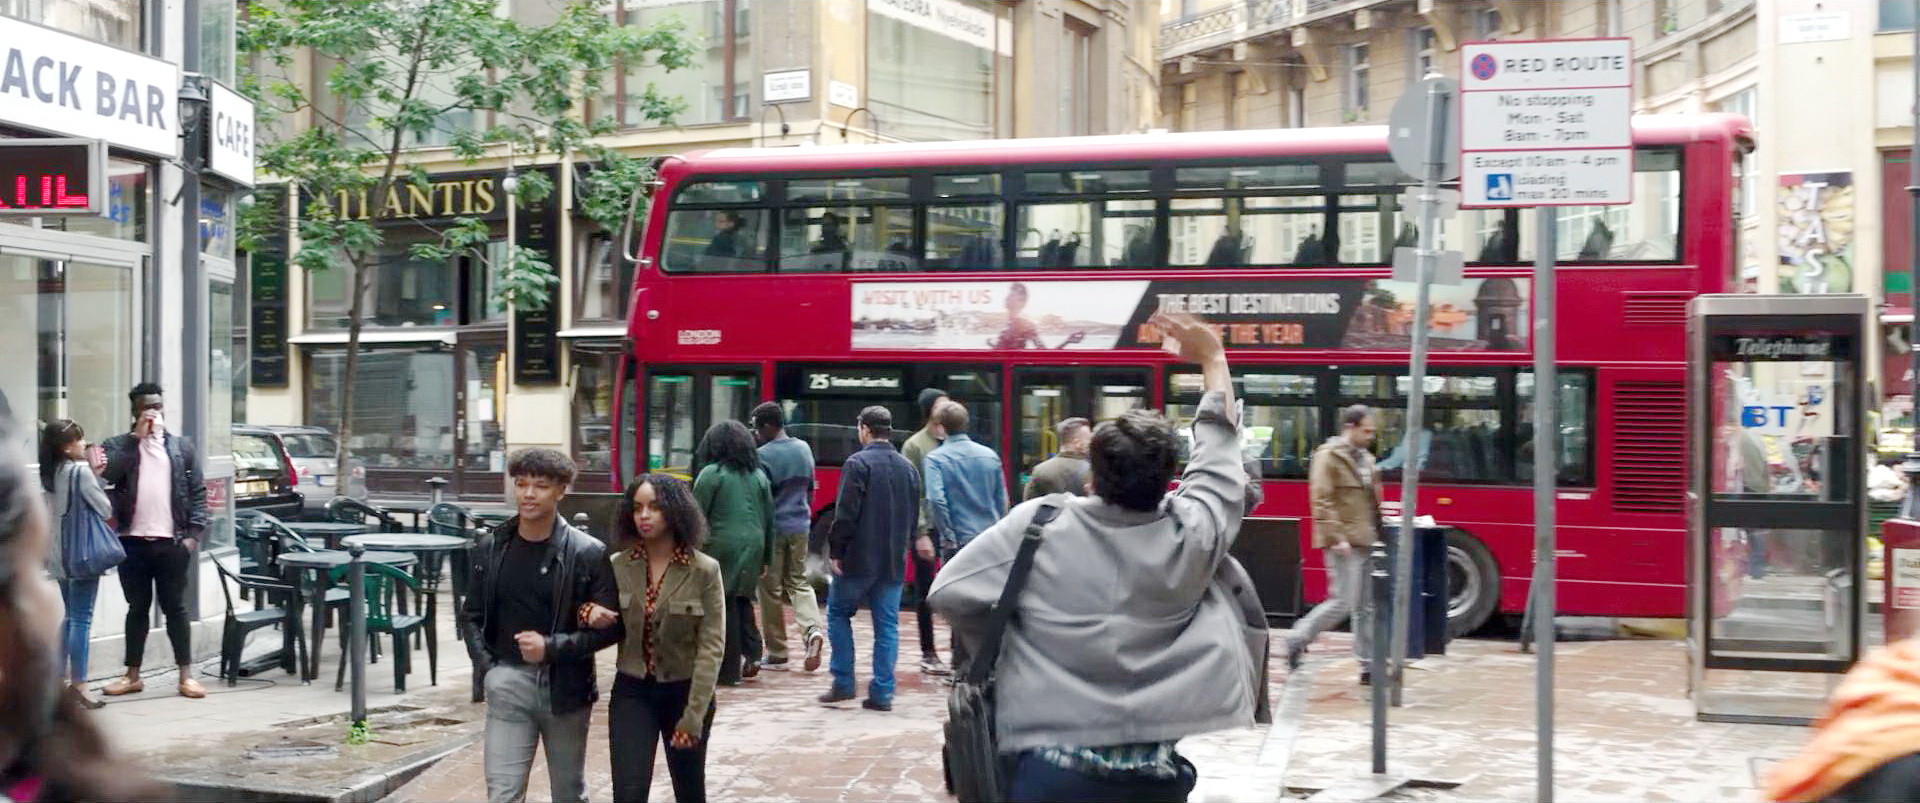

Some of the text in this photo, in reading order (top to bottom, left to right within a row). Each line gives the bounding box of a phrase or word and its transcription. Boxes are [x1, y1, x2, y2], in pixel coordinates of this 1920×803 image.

[1504, 55, 1625, 73] RED ROUTE
[0, 48, 167, 130] ACK BAR
[1498, 94, 1595, 108] No stopping
[1507, 112, 1543, 125] Mon
[1556, 110, 1585, 124] Sat
[216, 110, 249, 158] CAFE
[1504, 129, 1539, 142] 8am
[1554, 128, 1588, 141] 7pm
[1473, 156, 1522, 170] Except
[309, 178, 496, 222] ATLANTIS
[1517, 187, 1610, 200] max 20 mins
[862, 288, 992, 305] VISIT WITH US
[1157, 293, 1341, 314] THE BEST DESTINATIONS
[1230, 323, 1261, 344] THE
[1262, 323, 1304, 344] YEAR
[1735, 338, 1831, 358] Telephone
[809, 373, 830, 390] 25
